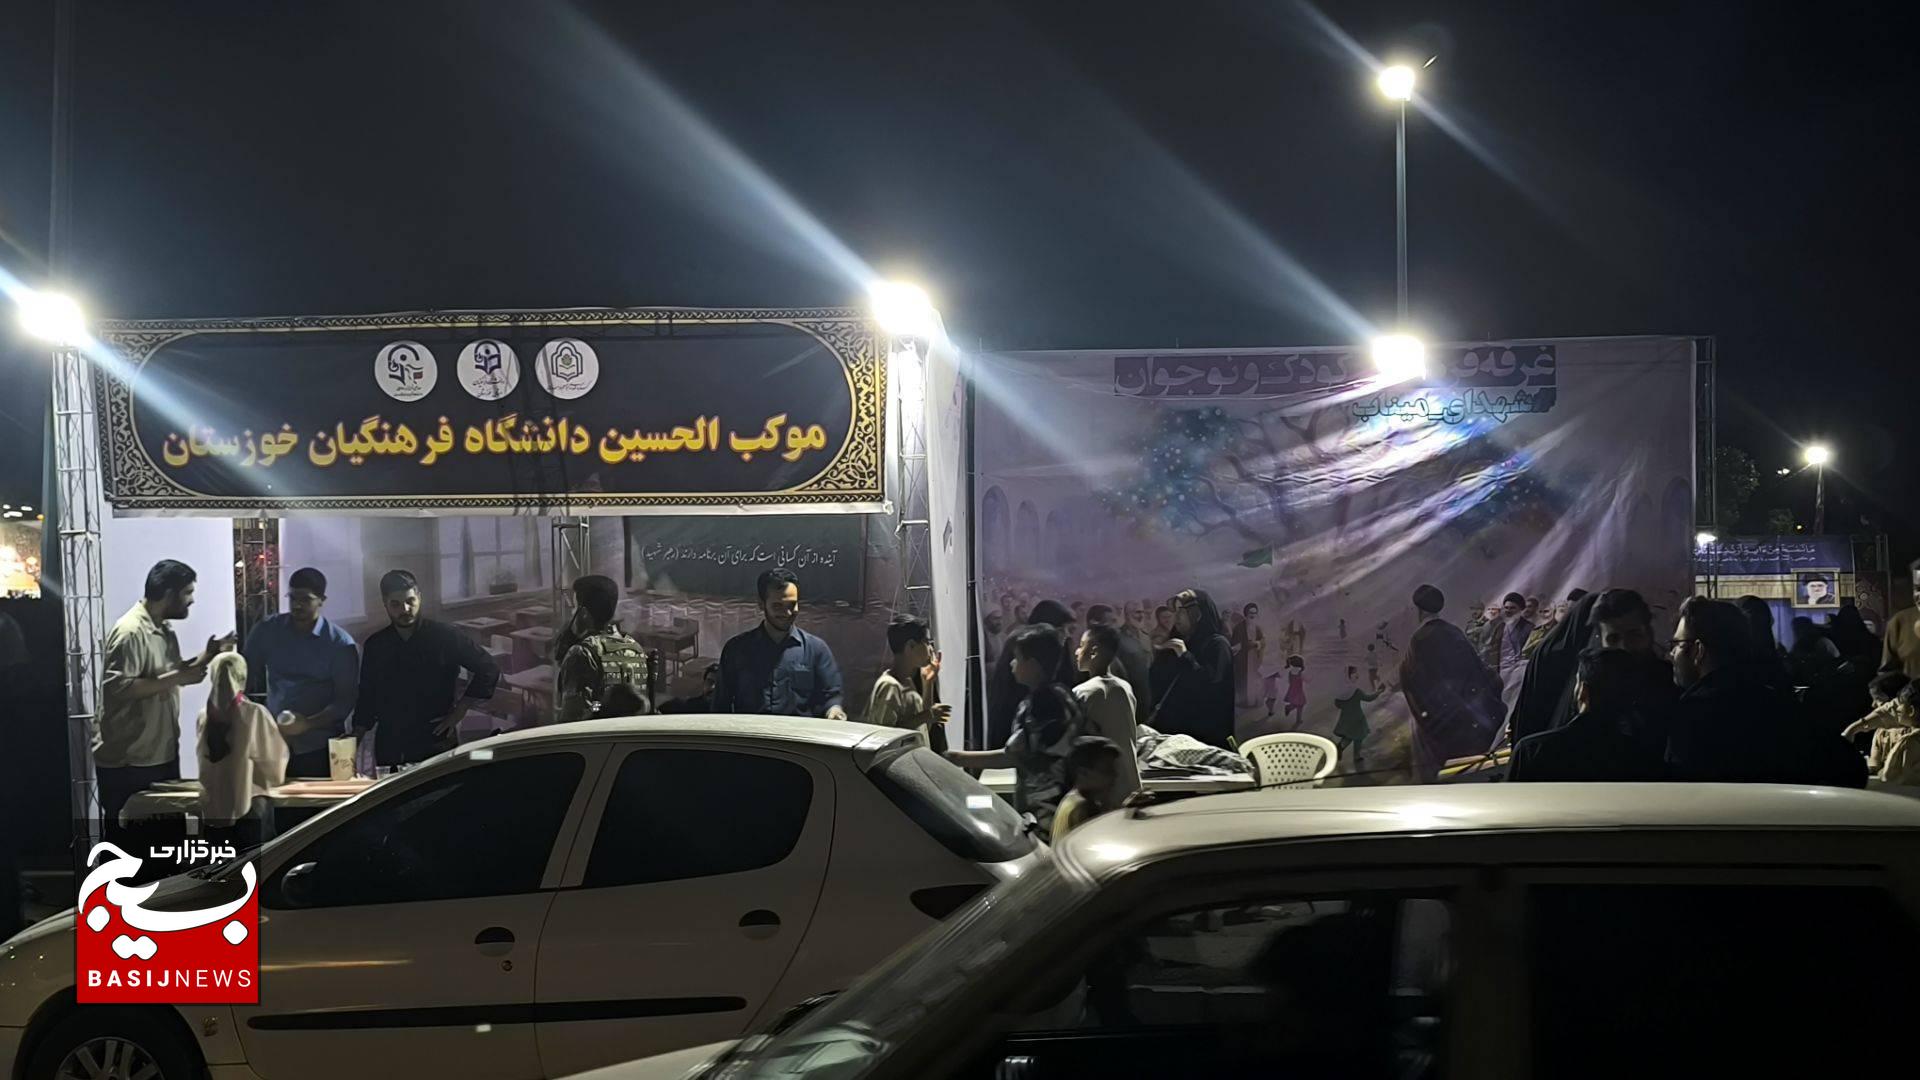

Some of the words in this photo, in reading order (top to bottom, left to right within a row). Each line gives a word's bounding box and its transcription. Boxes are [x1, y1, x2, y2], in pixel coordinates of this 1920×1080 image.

[162, 421, 299, 467] خوزستان
[308, 414, 455, 466] فرهنگیان
[464, 412, 591, 454] دانشگاه
[599, 414, 720, 464] الحسین
[728, 413, 827, 461] موکب
[718, 545, 733, 565] آن
[731, 549, 747, 565] برای
[749, 545, 760, 561] که
[757, 551, 776, 561] است
[777, 544, 800, 567] کسانی
[820, 549, 838, 567] آینده
